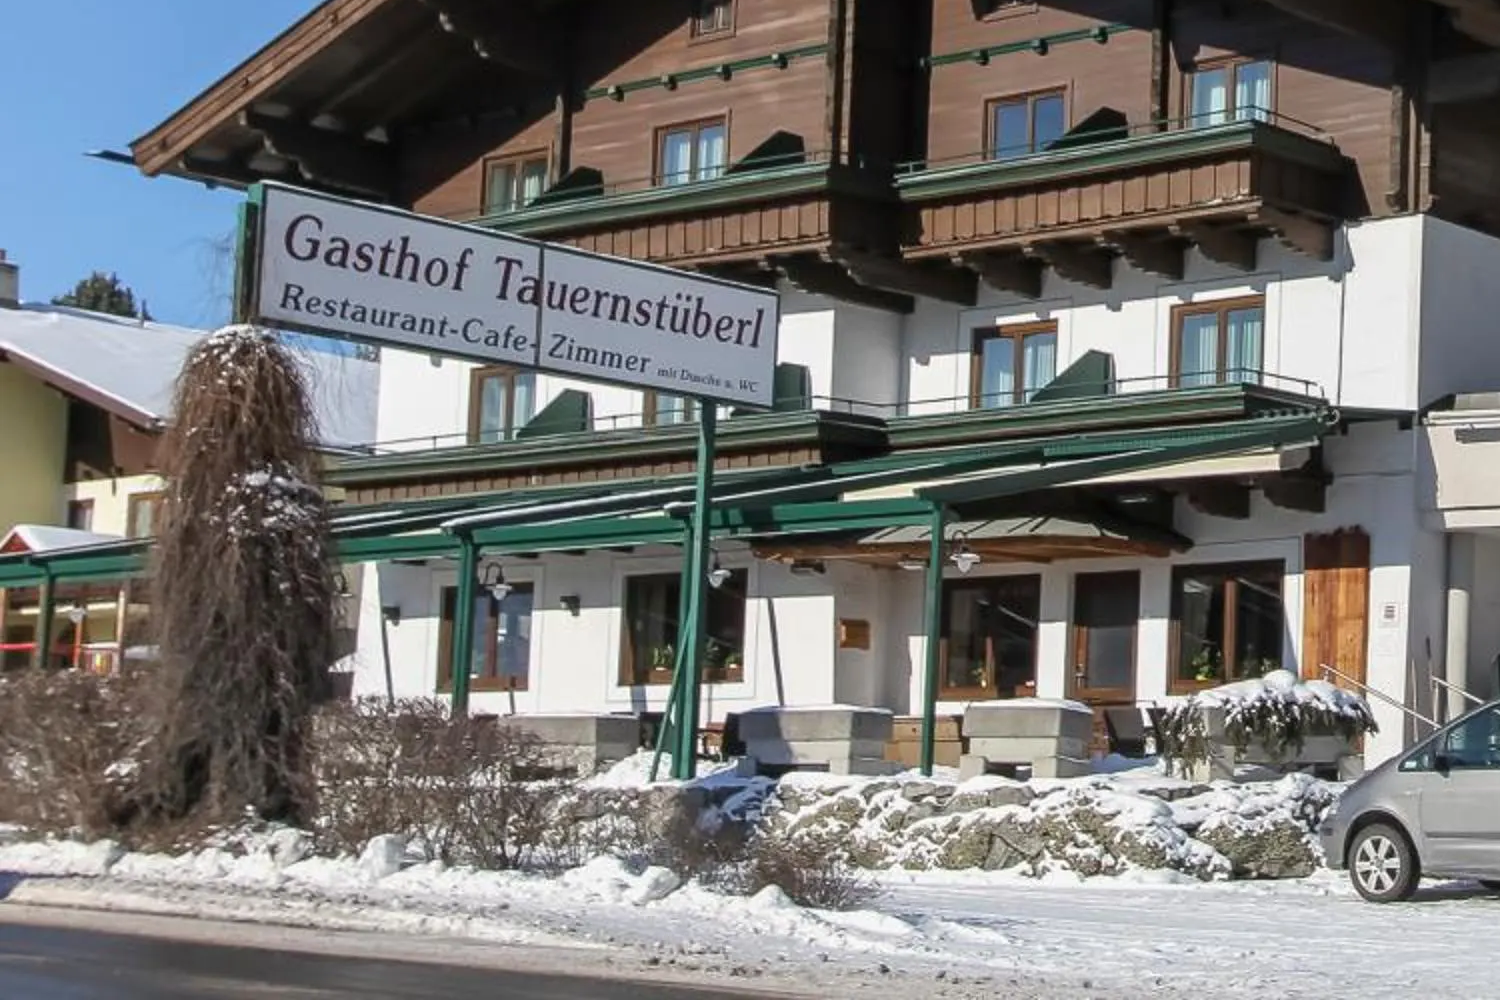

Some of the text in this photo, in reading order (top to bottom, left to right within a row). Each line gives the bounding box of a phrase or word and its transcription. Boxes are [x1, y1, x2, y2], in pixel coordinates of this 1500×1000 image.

[283, 213, 764, 348] Gasthof Tauernstüberl
[548, 333, 652, 373] Zimmer
[739, 379, 760, 393] WC
